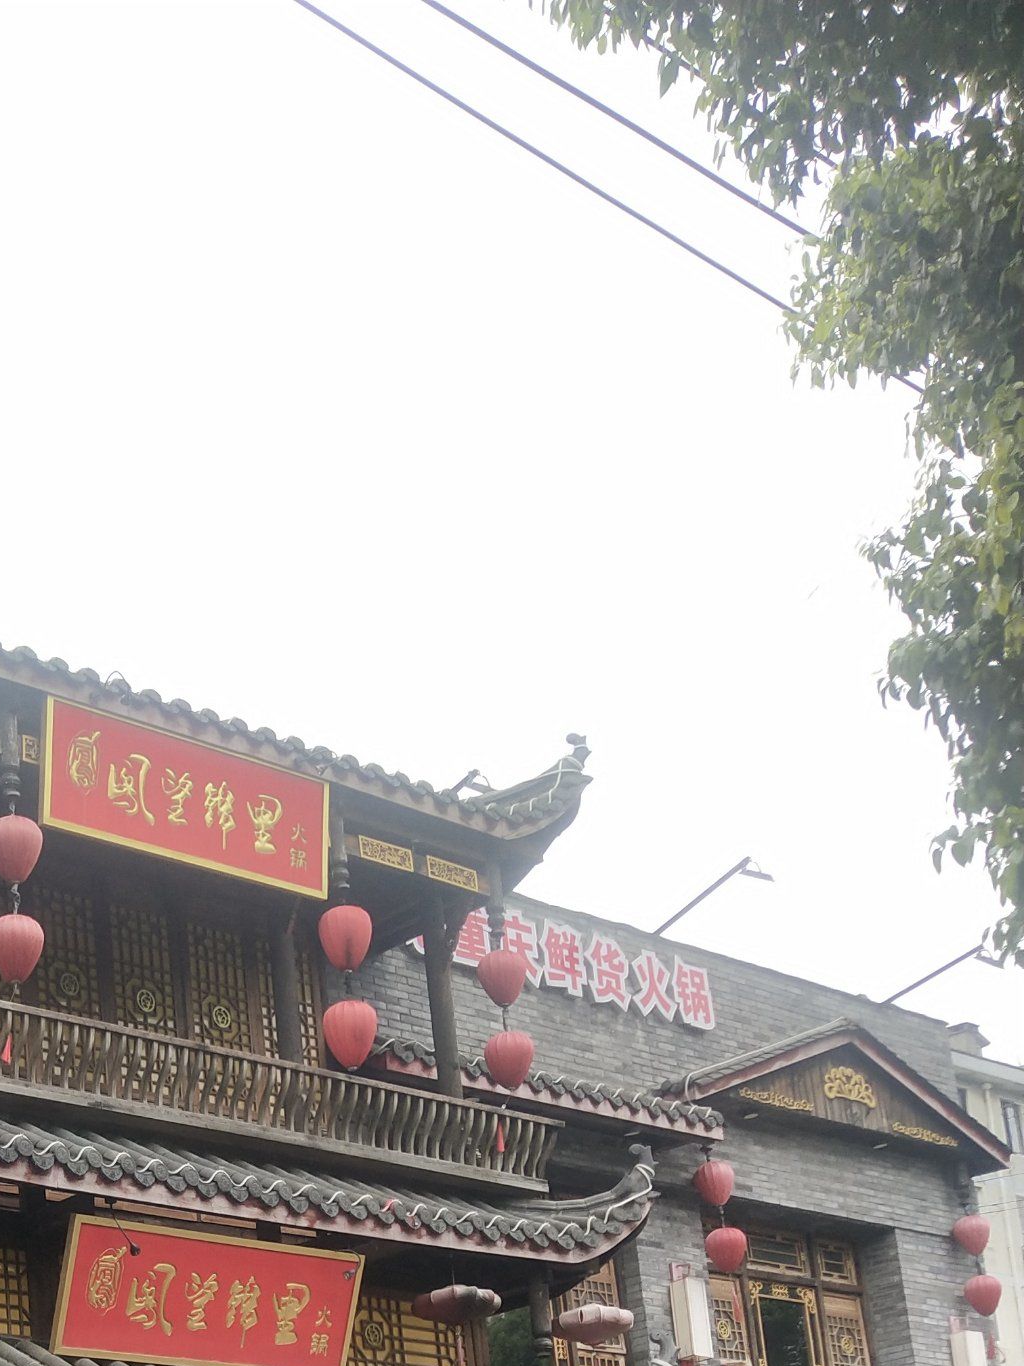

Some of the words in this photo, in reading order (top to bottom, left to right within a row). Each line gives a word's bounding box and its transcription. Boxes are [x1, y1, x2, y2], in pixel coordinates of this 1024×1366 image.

[405, 905, 714, 1029] 重庆鲜货火锅
